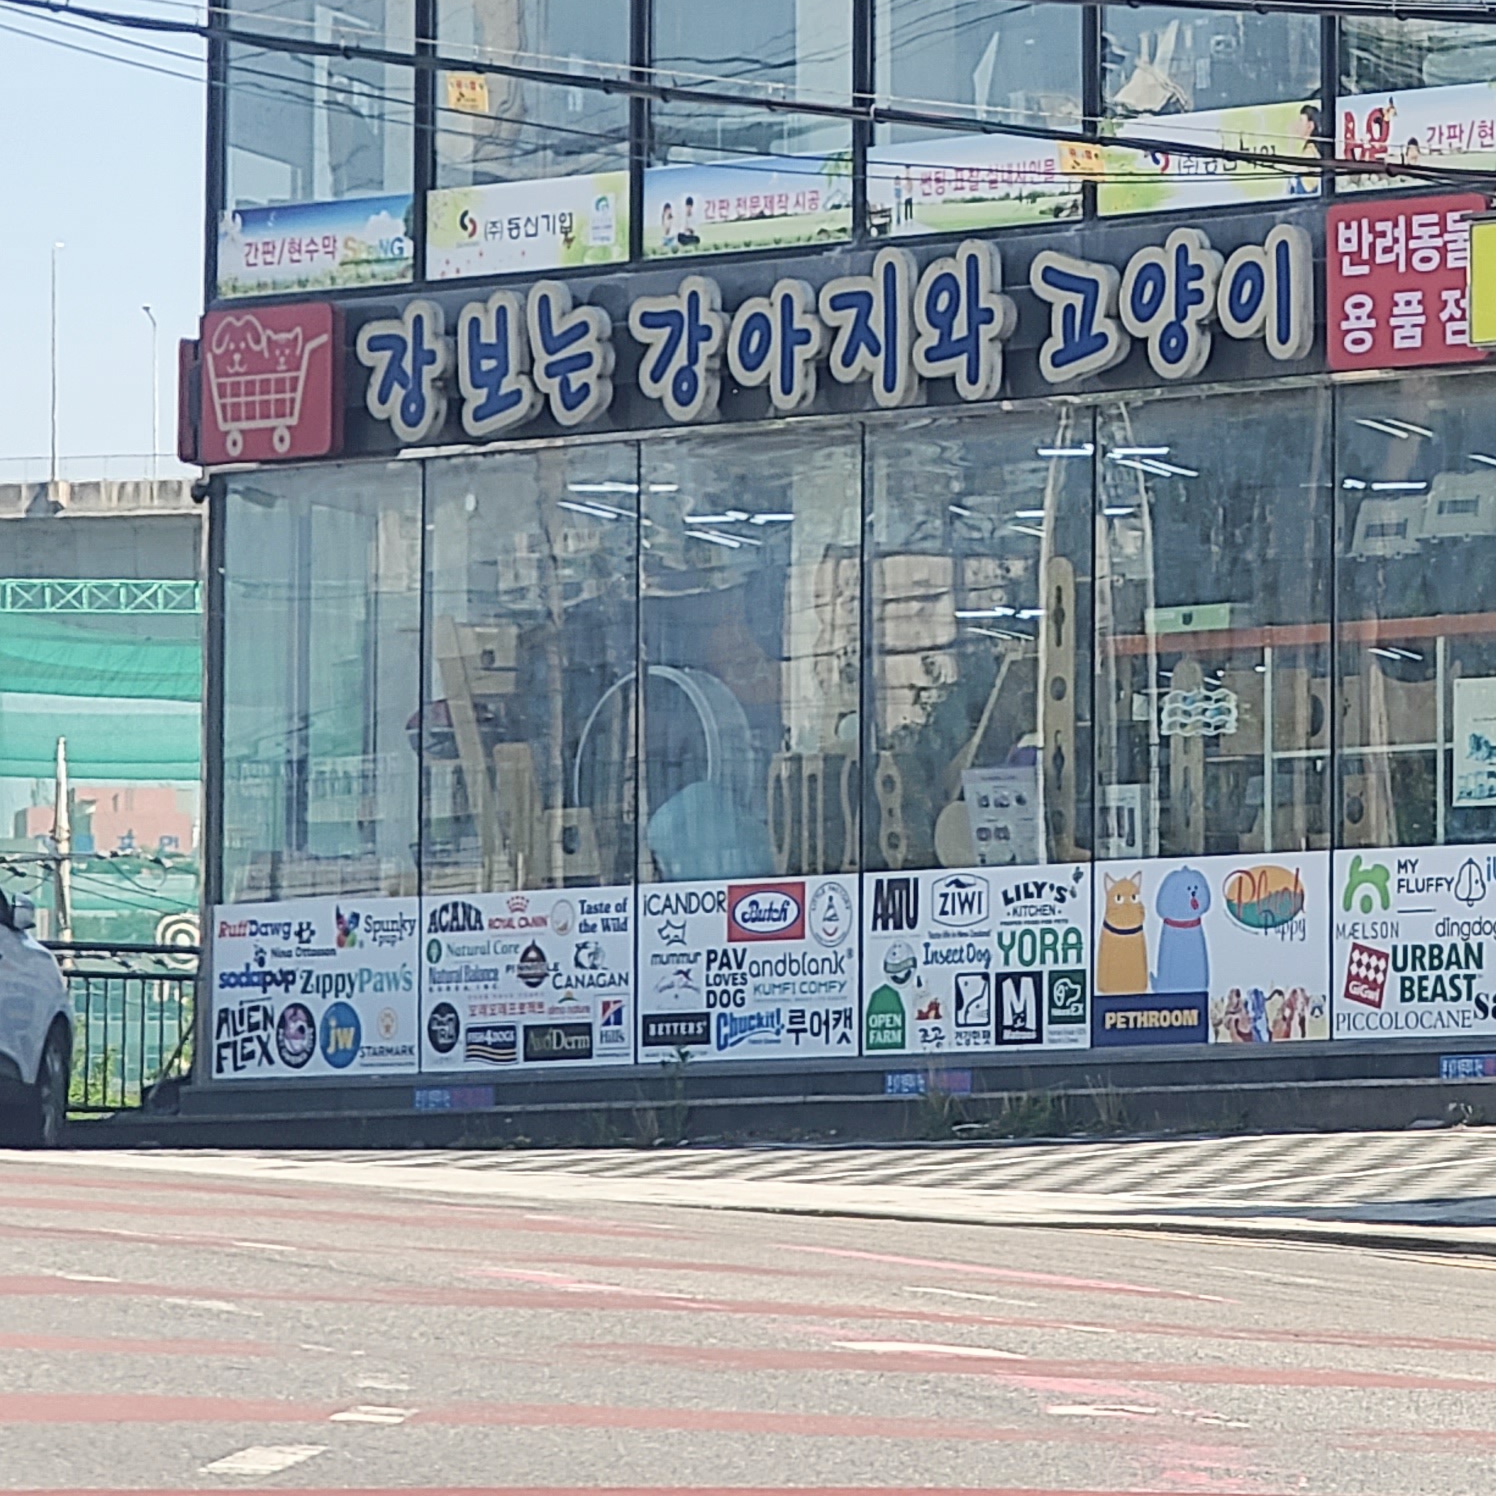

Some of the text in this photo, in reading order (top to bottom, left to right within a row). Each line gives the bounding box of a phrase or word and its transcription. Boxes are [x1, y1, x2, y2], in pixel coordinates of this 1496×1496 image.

[794, 189, 821, 212] 시공
[243, 234, 338, 268] 간판/현수막
[1337, 209, 1472, 277] 반려동물
[357, 222, 1310, 442] 장보는 강아지와 고양이
[1397, 858, 1419, 874] MY
[1001, 880, 1069, 907] LILY'S
[1397, 877, 1455, 894] FLUFFY
[578, 896, 629, 916] Taste of
[643, 889, 727, 916] iCANDOR
[938, 890, 984, 917] ZIWI
[218, 919, 293, 940] RuffDawg
[363, 911, 416, 941] Spunky
[426, 900, 485, 934] ACANA
[578, 916, 629, 934] the Wild
[706, 947, 748, 972] PAV
[922, 941, 993, 970] Insect Dog
[997, 926, 1084, 967] YORA
[1391, 941, 1484, 973] URBAN
[218, 962, 297, 994] sodapup
[552, 971, 630, 991] CANAGAN
[705, 972, 748, 988] LOVES
[799, 980, 848, 995] COMFY
[1399, 973, 1476, 1004] BEAST
[706, 988, 746, 1009] DOG
[215, 996, 275, 1041] ALIEN
[868, 1012, 903, 1029] OPEN
[1104, 1008, 1199, 1030] PETHROOM
[1335, 1009, 1473, 1032] PICCOLOCANE
[868, 1029, 903, 1045] FARM
[215, 1033, 276, 1074] FLEX
